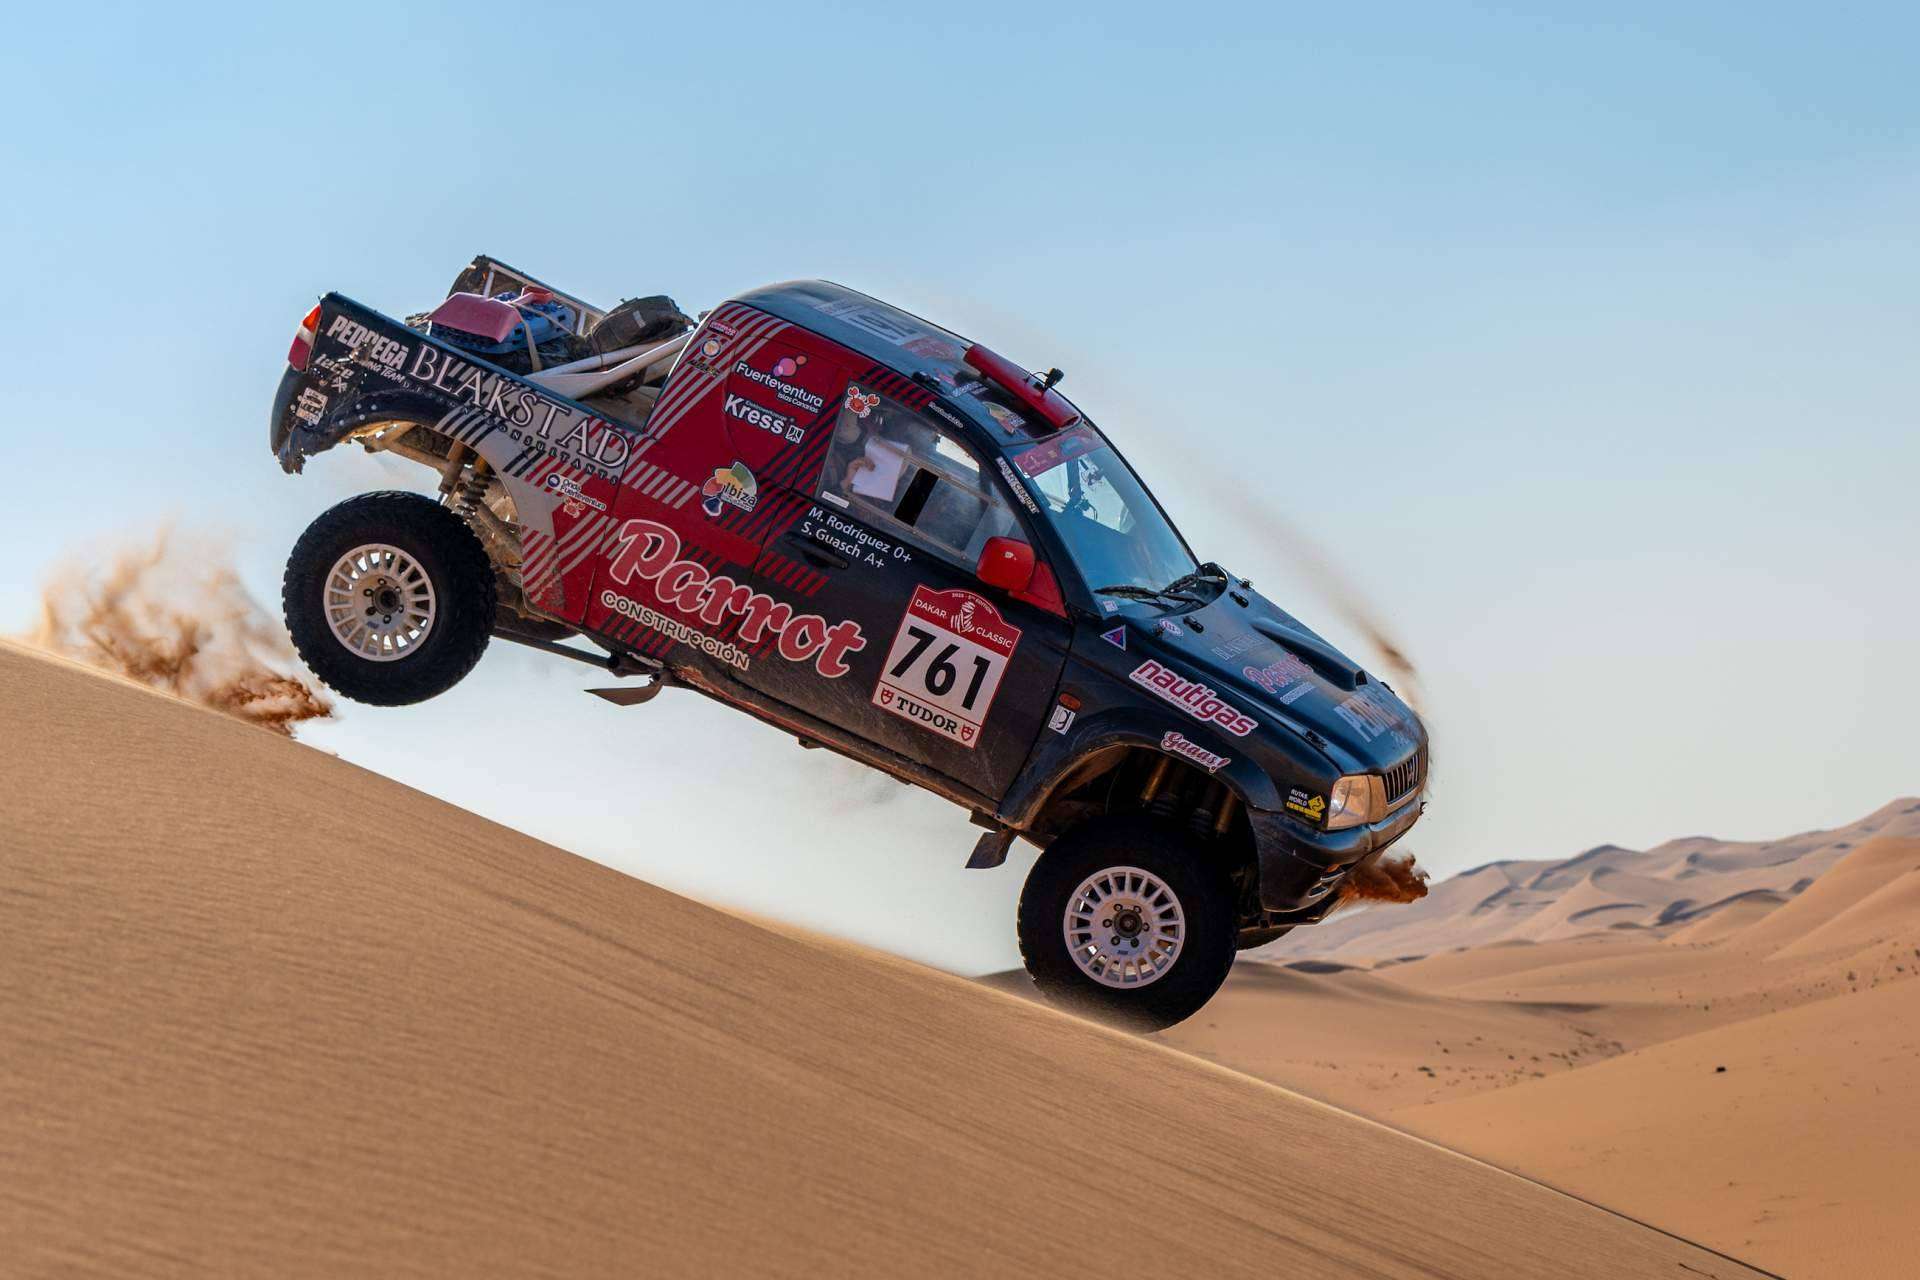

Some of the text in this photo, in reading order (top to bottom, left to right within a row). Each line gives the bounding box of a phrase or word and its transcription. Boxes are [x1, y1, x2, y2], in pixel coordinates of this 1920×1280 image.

[380, 365, 406, 383] TEAM
[736, 363, 824, 407] Fuerteventura
[409, 344, 630, 467] BLAKSTAD
[725, 394, 785, 434] Kress
[801, 521, 885, 568] S. Guasch A+
[808, 506, 824, 522] M.
[826, 515, 891, 553] Rodríguez
[609, 519, 867, 678] Parrot
[601, 590, 749, 671] CONSTRUCCIÓN
[915, 600, 1013, 648] DAKAR CLASSIC
[890, 625, 991, 711] 761
[897, 697, 959, 734] TUDOR
[1136, 661, 1256, 734] nautigas
